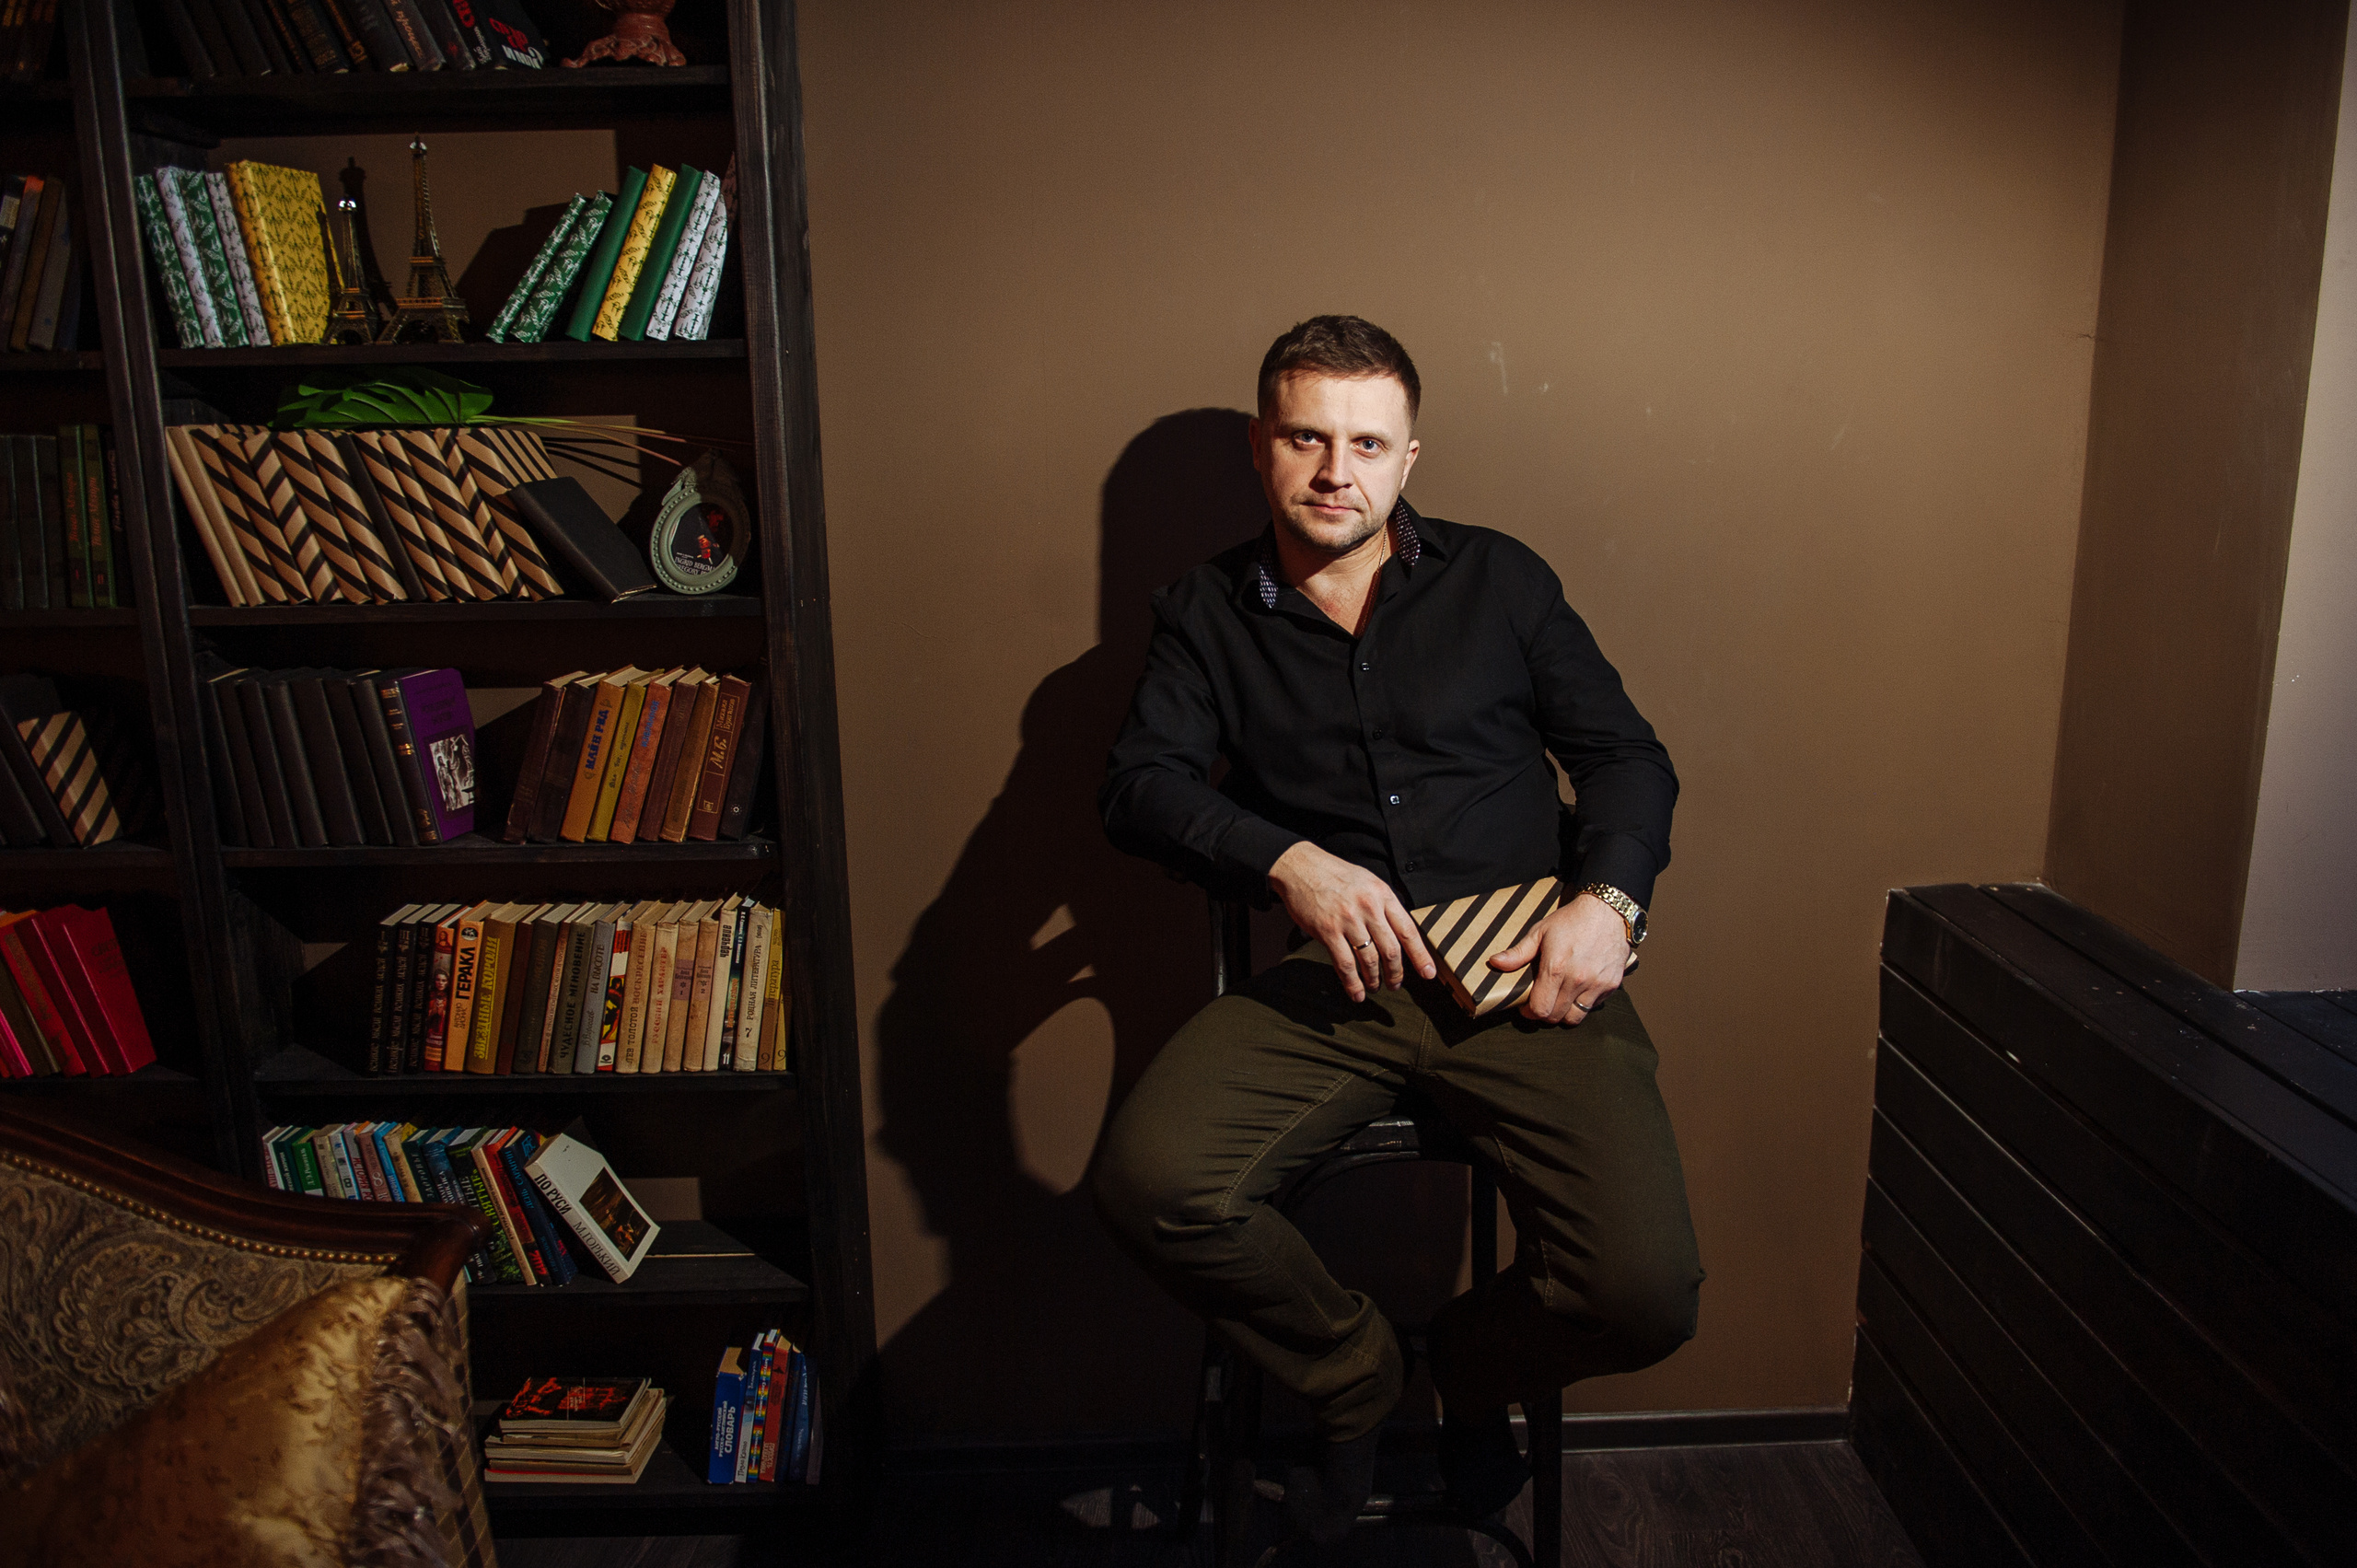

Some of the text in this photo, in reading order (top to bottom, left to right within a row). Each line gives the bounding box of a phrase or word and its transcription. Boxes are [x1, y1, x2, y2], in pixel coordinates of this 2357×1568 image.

[641, 700, 660, 748] ИЗБРАННОЕ
[586, 736, 602, 770] МАЙН
[720, 924, 733, 958] черчение
[456, 947, 475, 1000] ГЕРАКЛ
[589, 944, 605, 994] НА ВЫСОТЕ
[656, 947, 668, 996] ХАРАКТЕР
[750, 945, 762, 990] ЛИТЕРАТУРА
[765, 959, 781, 1010] Литература
[473, 935, 497, 1059] ЗВЕЗДНЫЕ КОРОЛИ
[560, 931, 586, 1059] ЧУДЕСНОЕ МГНОВЕНИЕ
[625, 932, 647, 1064] ЛЕВ ТОЛСТОЙ ВОСКРЕСЕНИЕ
[747, 992, 758, 1021] РОДНАЯ
[745, 1028, 753, 1039] 7
[723, 1052, 730, 1065] 11
[761, 1051, 771, 1065] 9
[353, 1157, 369, 1190] ИСТОРИЯ
[505, 1149, 525, 1187] САРАНЧИ
[521, 1188, 535, 1210] ДЕНЬ
[534, 1172, 551, 1191] ПО
[546, 1187, 573, 1216] РУСИ
[572, 1221, 621, 1276] М.ГОРЬКИЙ
[714, 1407, 723, 1451] АНГЛО-РУССКИЙ
[725, 1406, 737, 1455] СЛОВАРЬ
